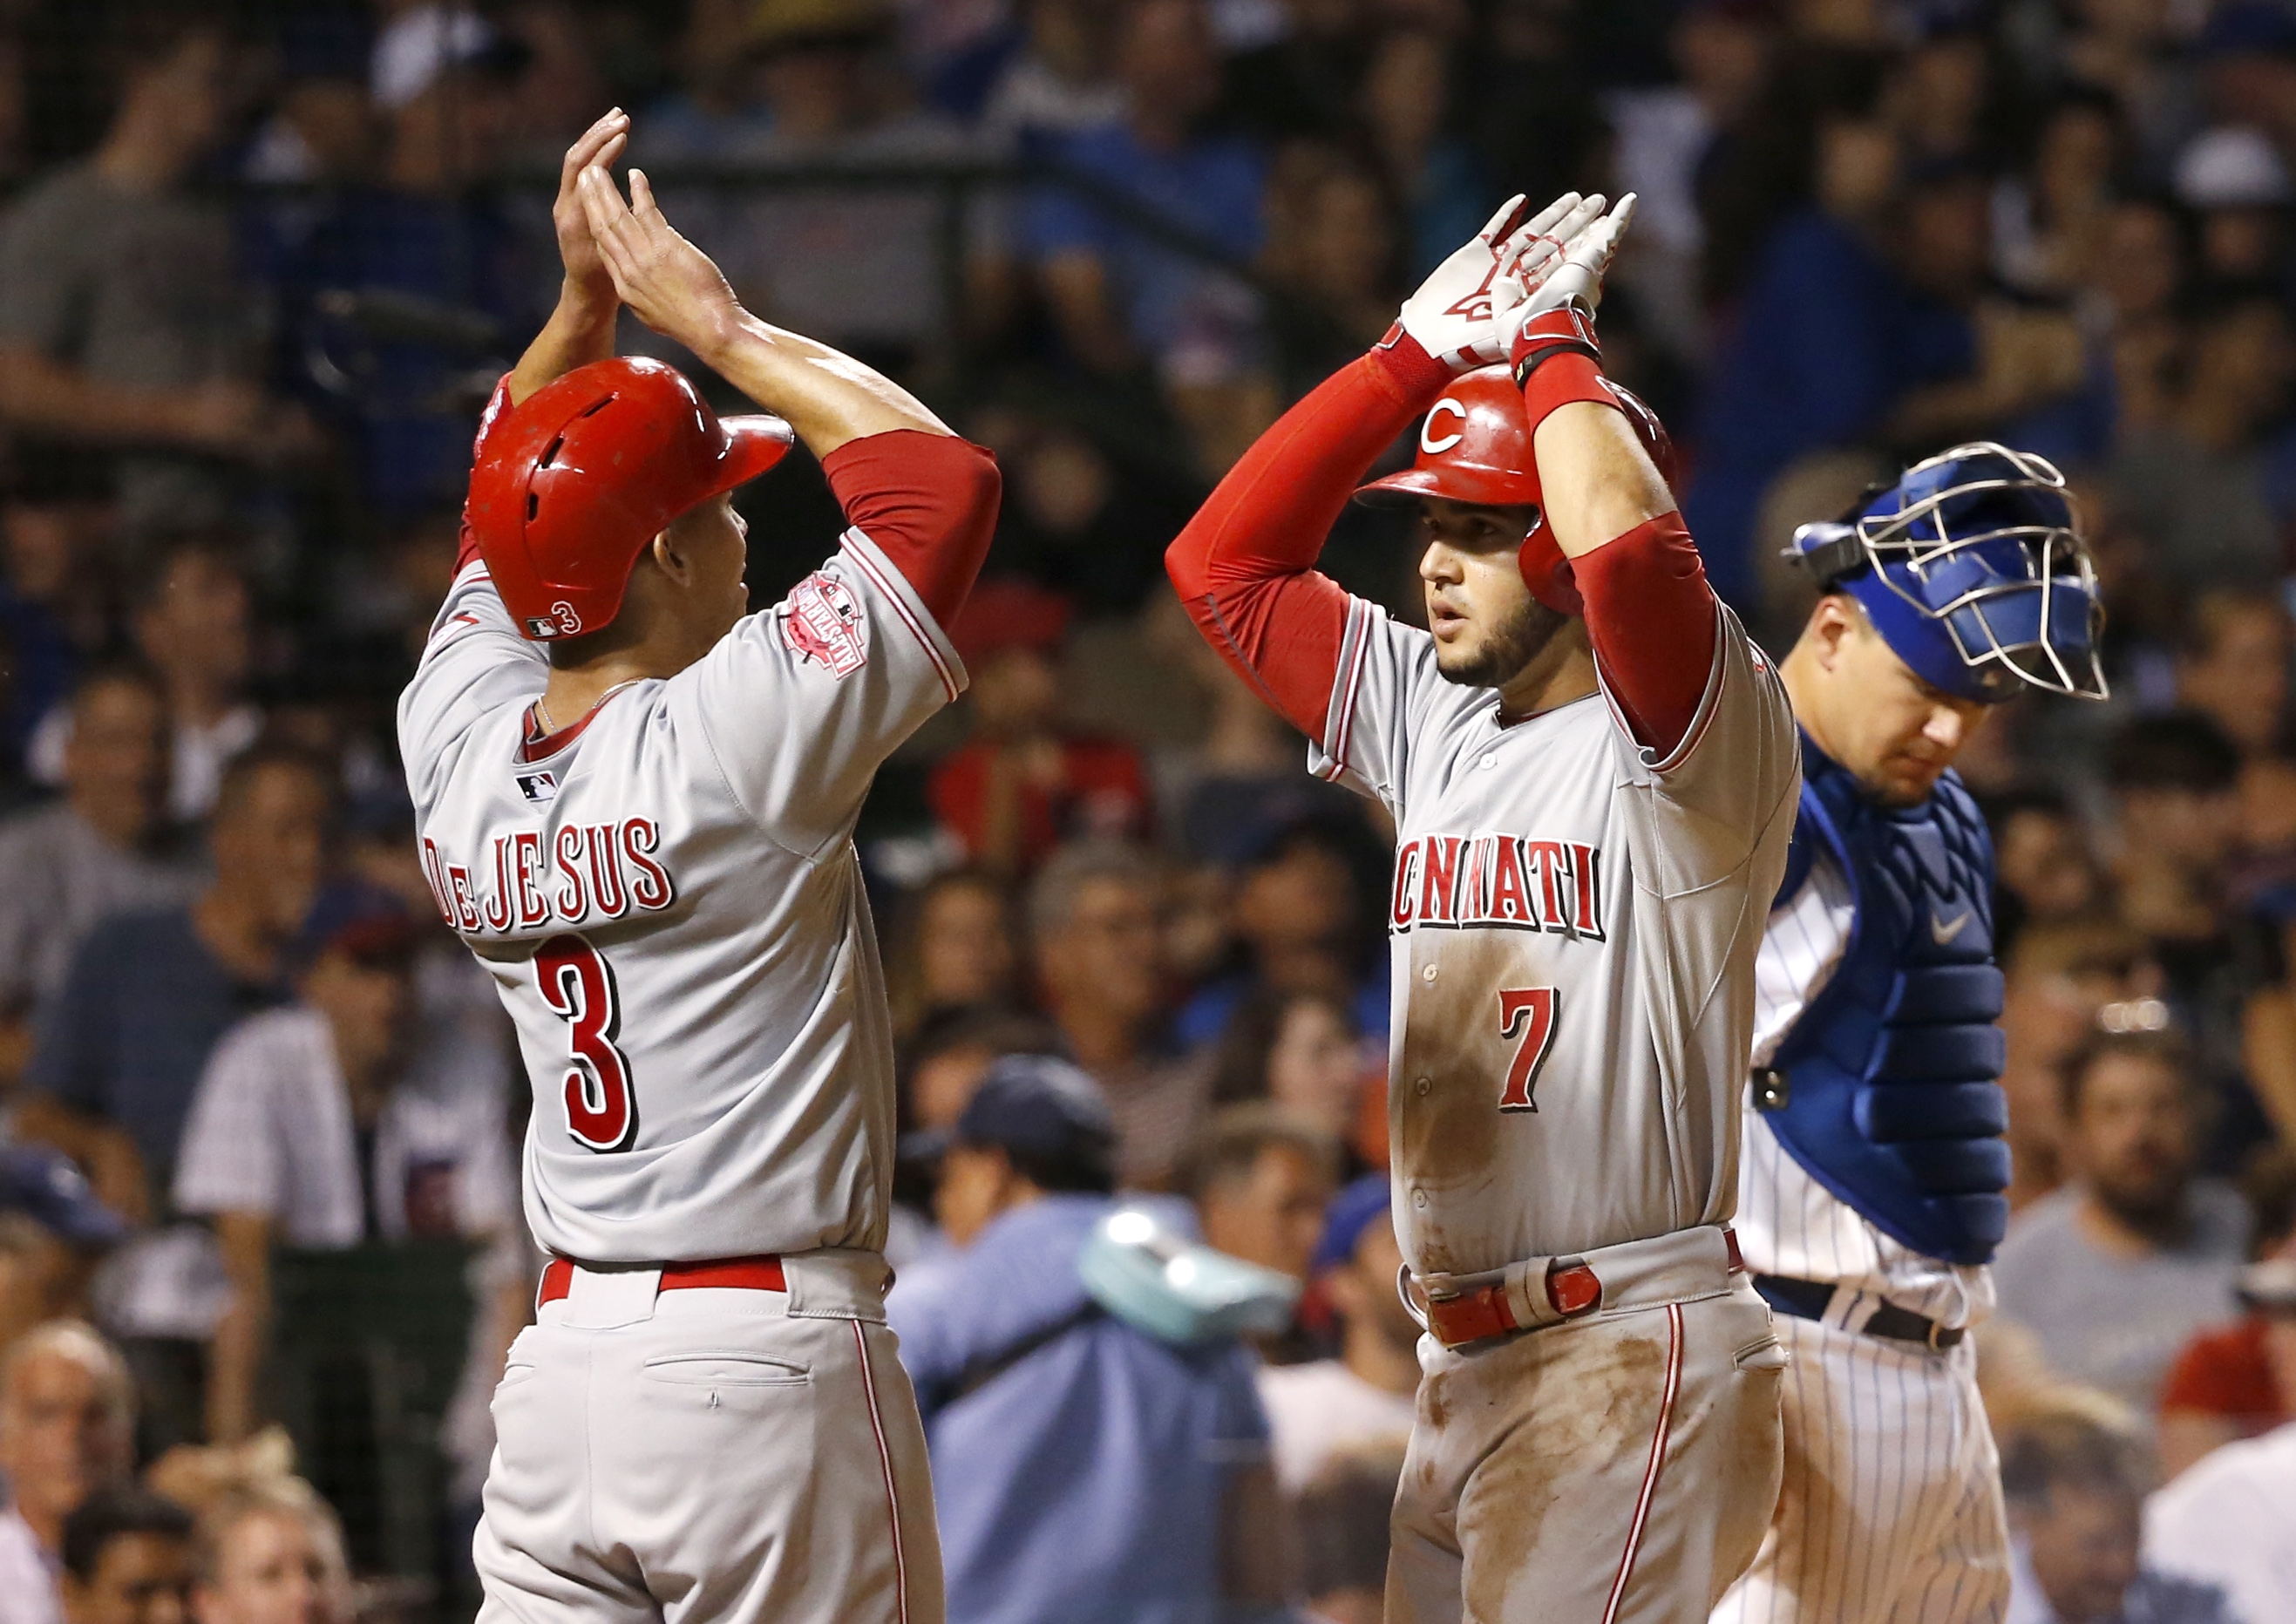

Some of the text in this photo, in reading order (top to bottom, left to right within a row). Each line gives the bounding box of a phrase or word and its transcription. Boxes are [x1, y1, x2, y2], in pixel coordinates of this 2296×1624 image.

[1420, 398, 1467, 454] C
[551, 600, 582, 635] 3
[805, 602, 844, 643] STAR
[829, 634, 859, 670] ALL
[532, 931, 639, 1153] 3
[1498, 985, 1560, 1112] 7
